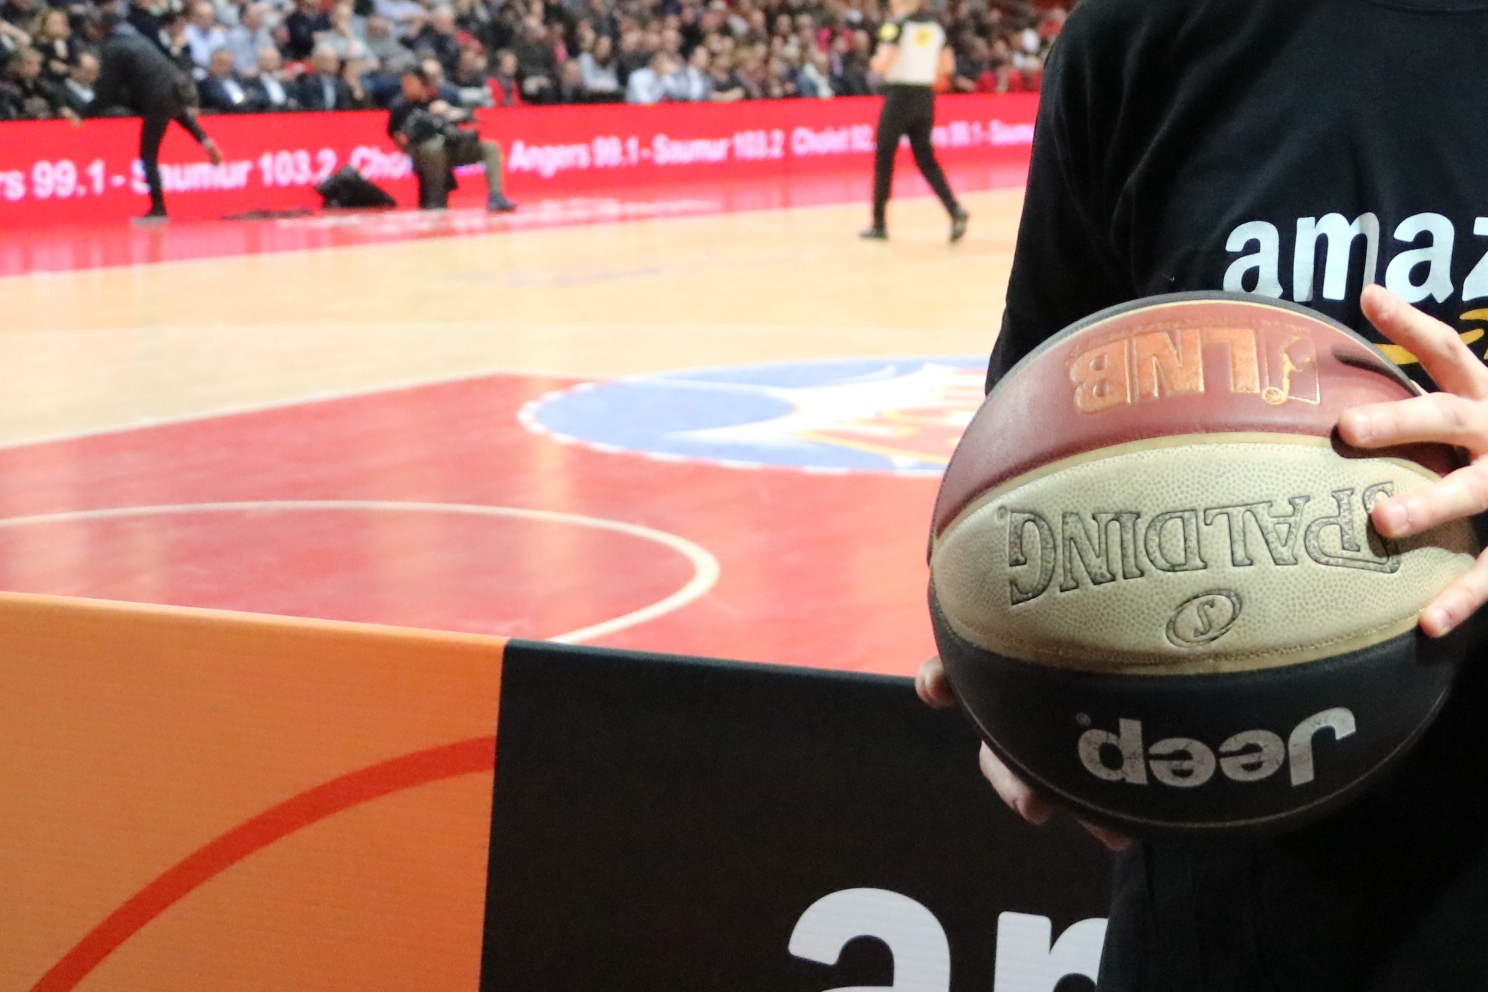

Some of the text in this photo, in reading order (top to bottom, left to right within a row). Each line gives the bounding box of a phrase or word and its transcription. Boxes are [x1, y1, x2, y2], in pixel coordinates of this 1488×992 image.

[32, 160, 105, 199] 99.1
[259, 148, 337, 186] 103.2
[507, 139, 592, 179] Angers
[1070, 328, 1261, 415] LNB
[1077, 706, 1357, 788] Jeep
